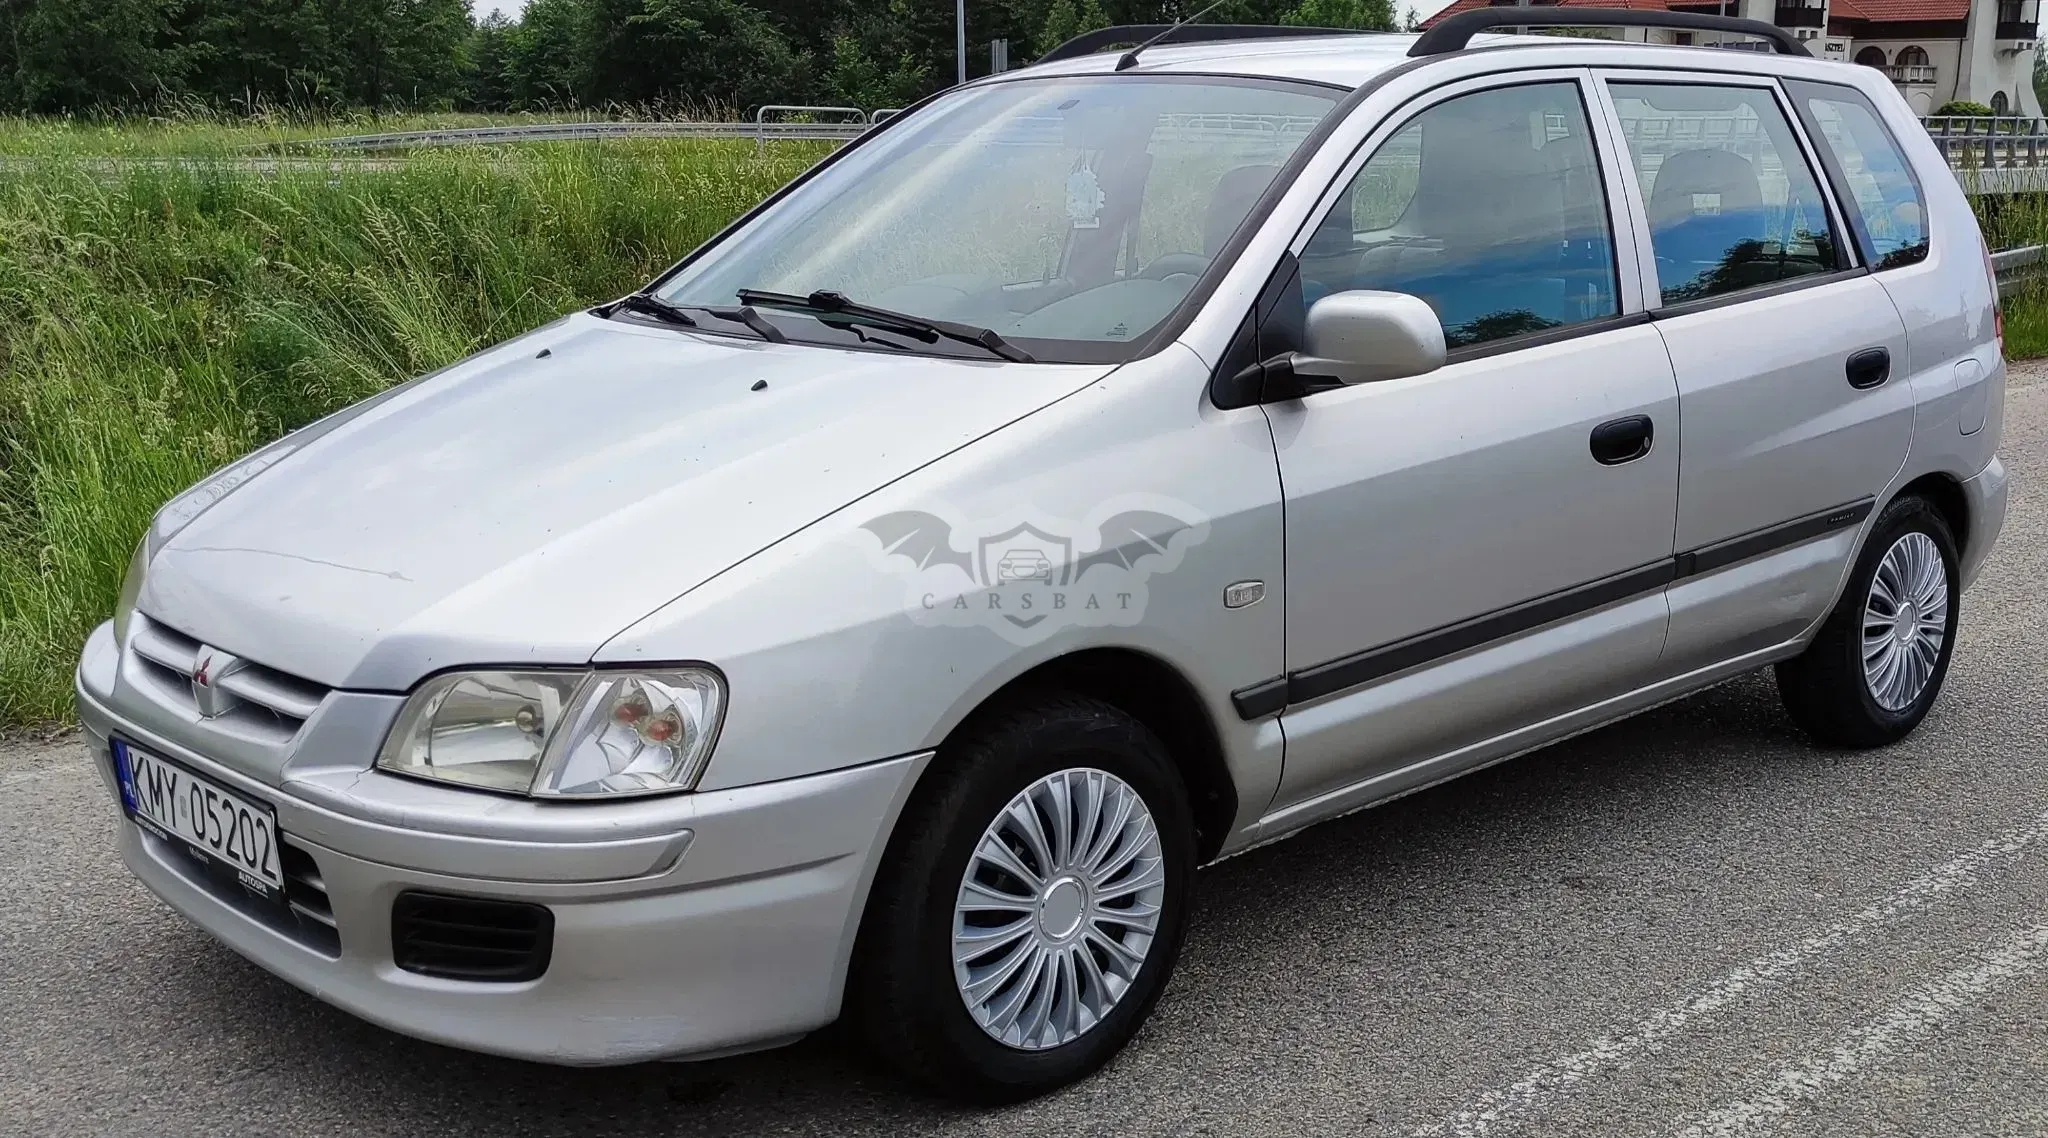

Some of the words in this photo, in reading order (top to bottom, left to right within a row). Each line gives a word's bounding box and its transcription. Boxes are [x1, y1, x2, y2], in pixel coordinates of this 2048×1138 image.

[124, 780, 135, 798] PL
[129, 751, 177, 828] KMY
[190, 782, 277, 881] 05202
[238, 870, 268, 894] AUTOSPA
